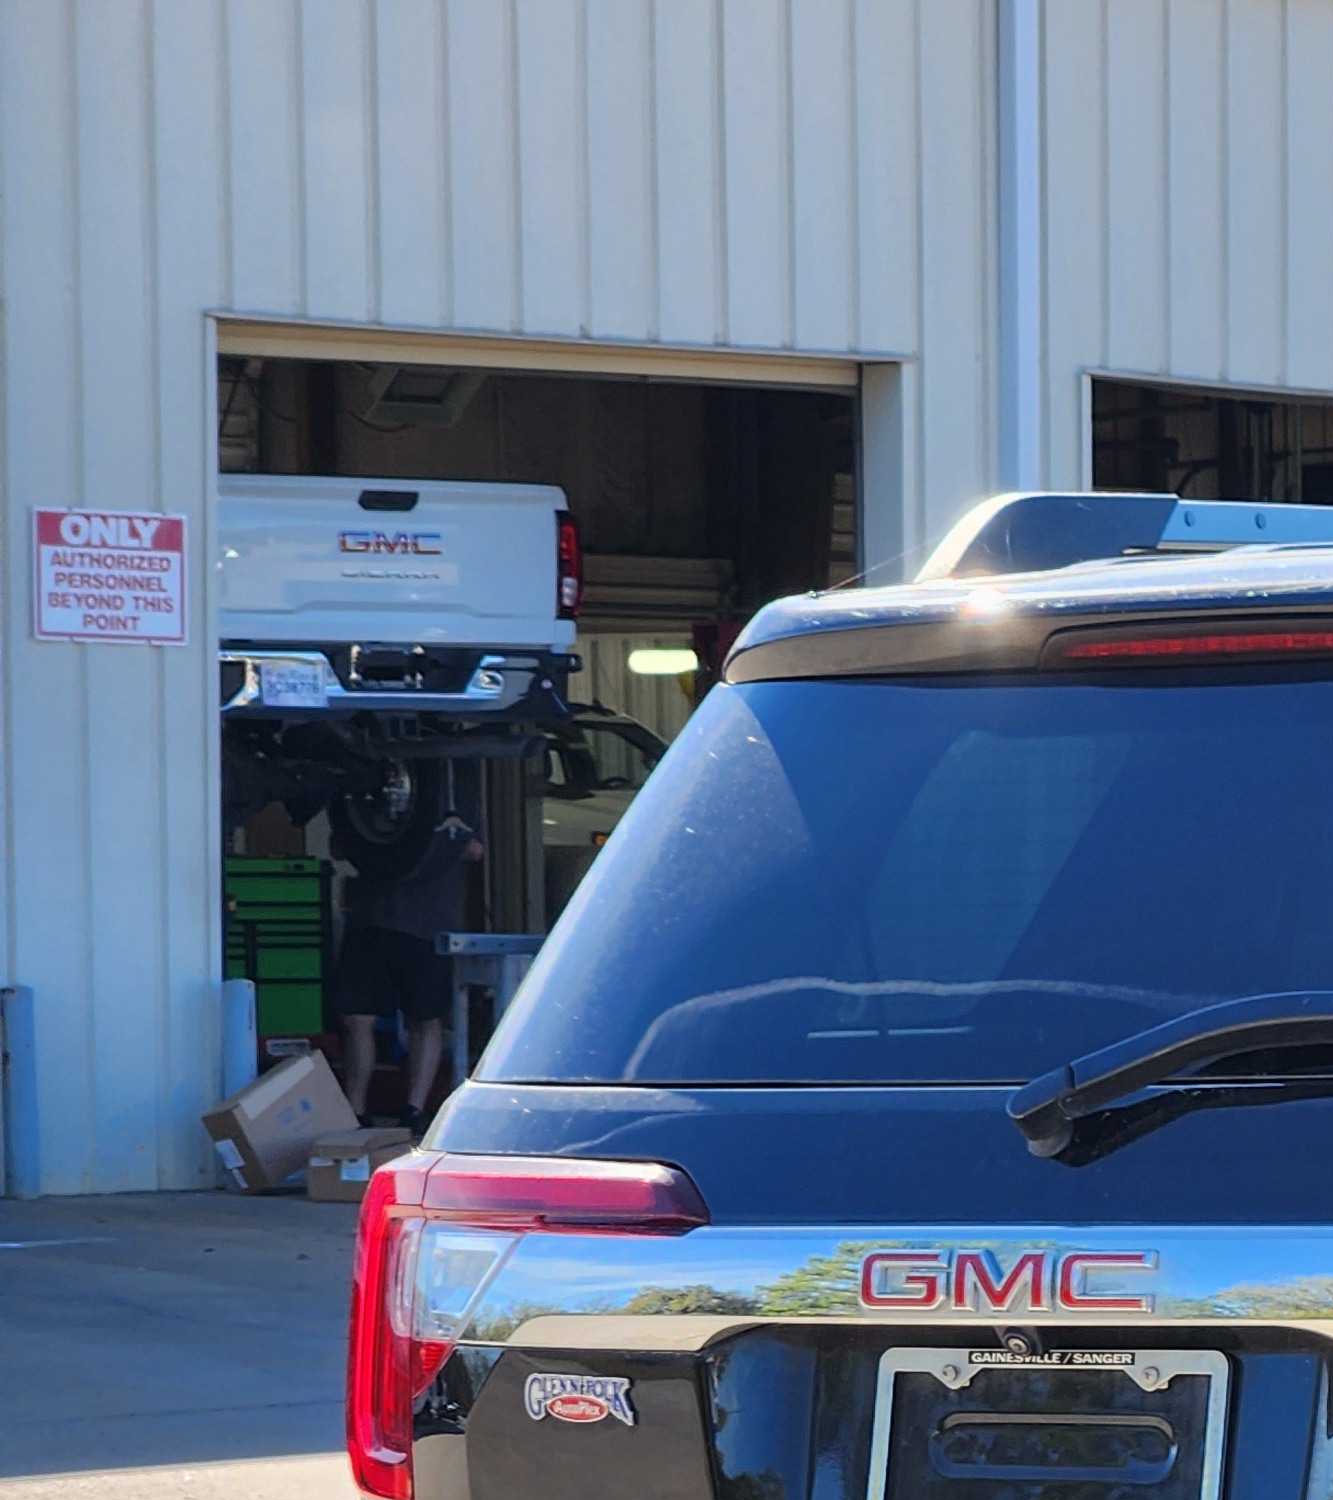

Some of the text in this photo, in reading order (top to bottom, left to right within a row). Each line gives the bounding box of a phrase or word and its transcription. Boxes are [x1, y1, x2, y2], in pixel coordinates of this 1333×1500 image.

[60, 515, 160, 548] ONLY
[338, 530, 443, 555] GMC
[51, 551, 171, 572] AUTHORIZED
[55, 572, 167, 592] PERSONNEL
[48, 592, 174, 613] BEYOND THIS
[83, 614, 140, 631] POINT
[860, 1249, 1158, 1313] GMC
[970, 1352, 1061, 1364] GAINESVILLE
[1072, 1353, 1133, 1365] SANGER
